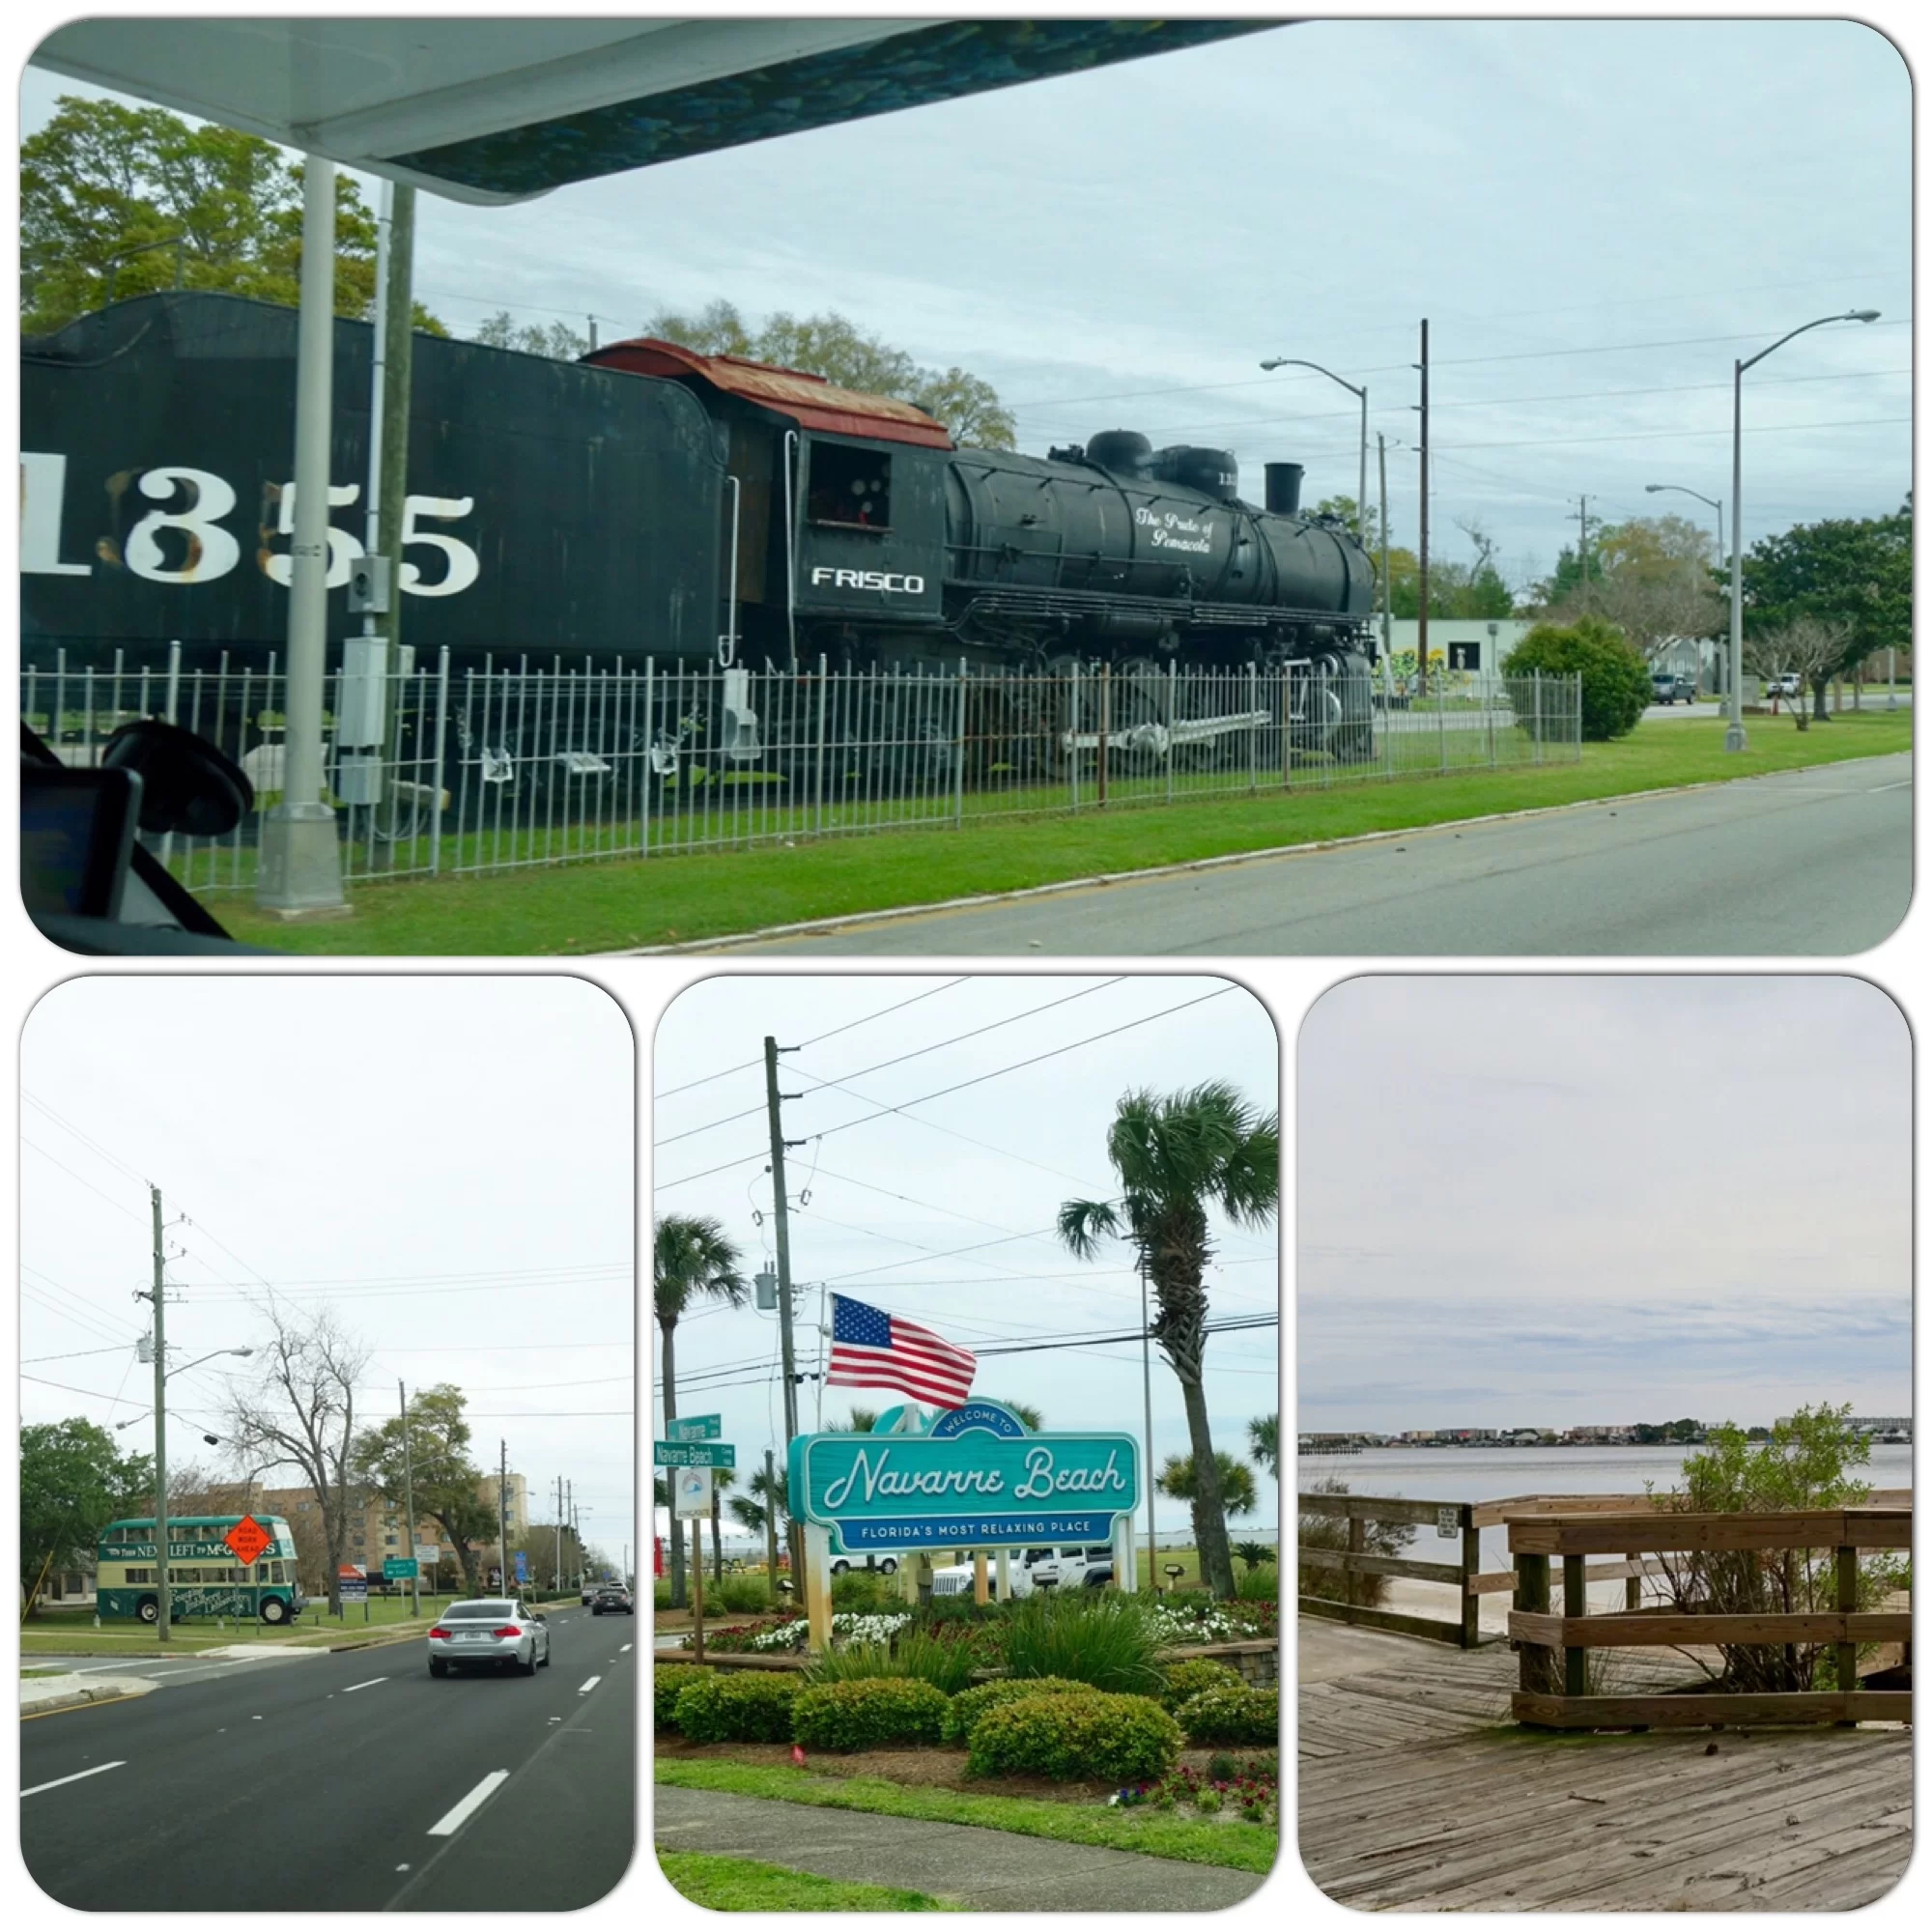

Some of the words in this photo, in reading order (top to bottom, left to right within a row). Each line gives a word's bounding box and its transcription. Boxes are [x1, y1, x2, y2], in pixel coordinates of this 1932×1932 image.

[1135, 507, 1161, 527] The
[1202, 522, 1214, 539] of
[811, 567, 924, 594] FRISCO
[944, 1409, 997, 1434] WELCOME
[999, 1417, 1012, 1433] TO
[656, 1445, 688, 1464] Navarre
[689, 1445, 713, 1464] Beach
[824, 1447, 1005, 1510] Navarre
[1013, 1446, 1126, 1499] Beach
[861, 1524, 933, 1539] FLORIDA'S
[938, 1523, 975, 1537] MOST
[980, 1521, 1045, 1535] RELAXING
[1050, 1520, 1091, 1533] PLACE
[137, 1545, 157, 1558] NEX
[169, 1544, 196, 1557] LEFT
